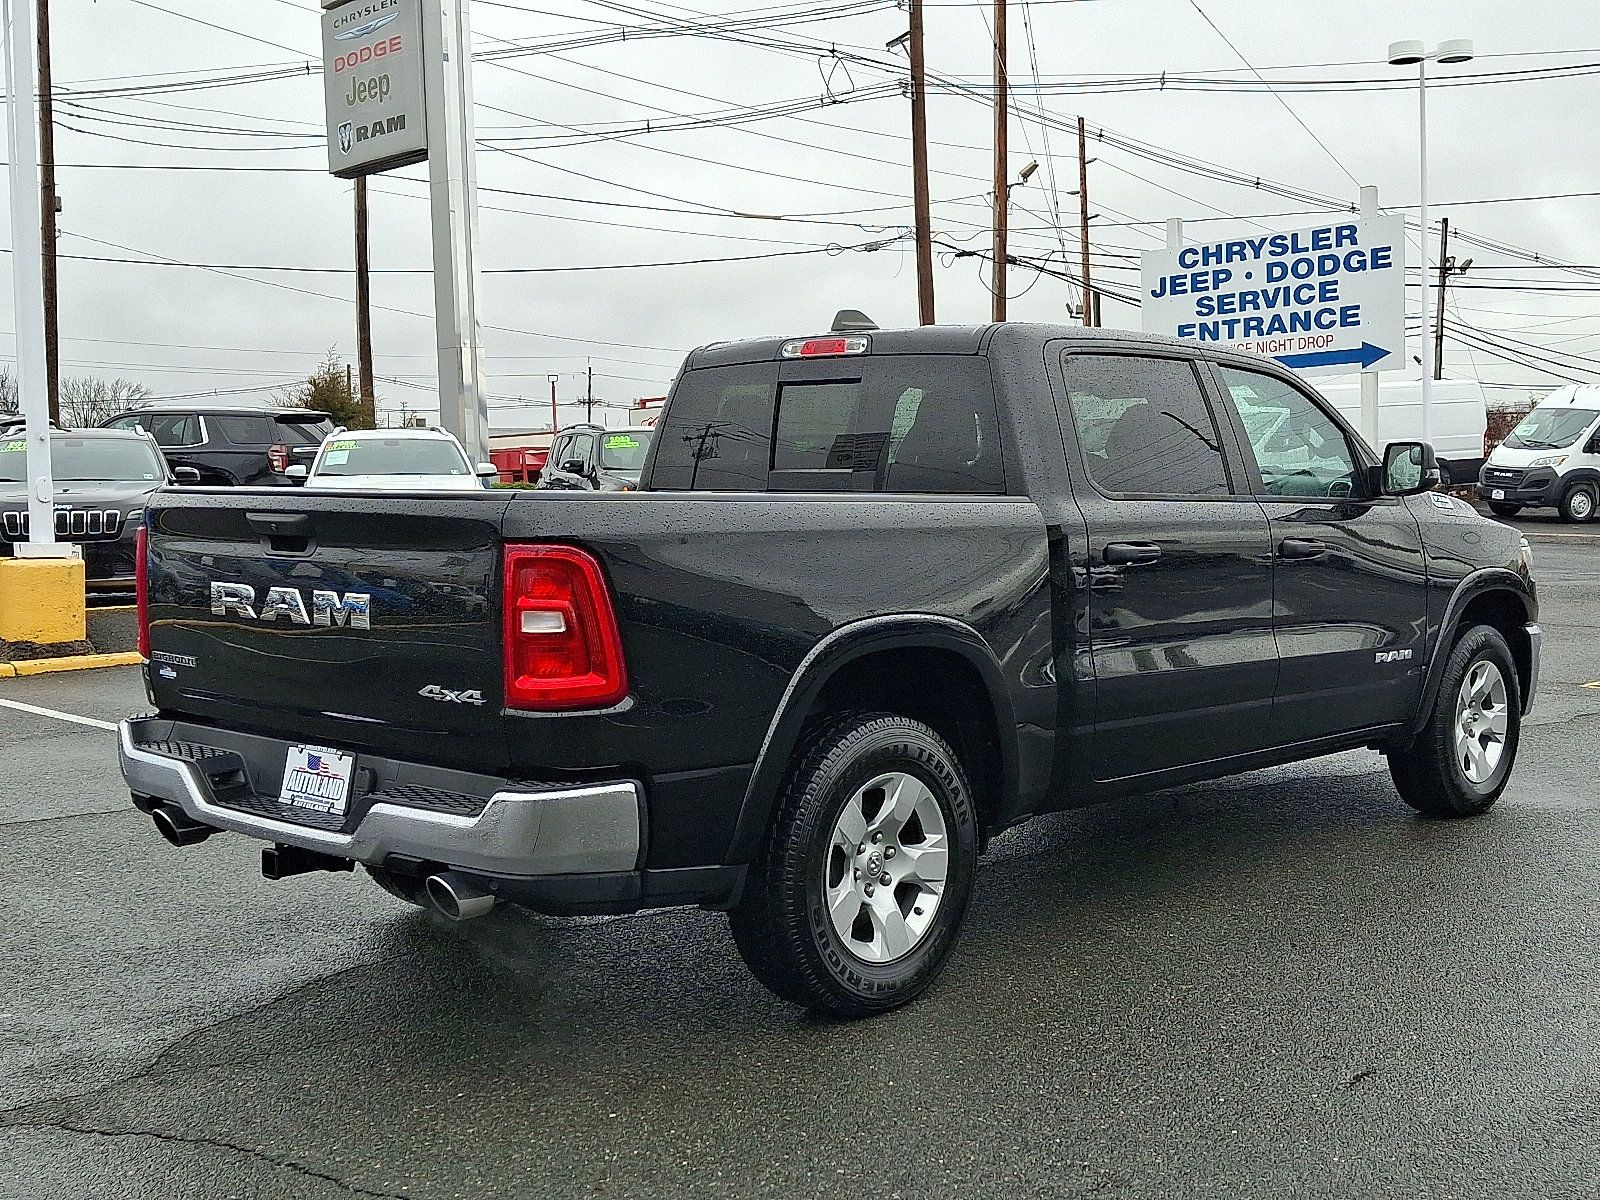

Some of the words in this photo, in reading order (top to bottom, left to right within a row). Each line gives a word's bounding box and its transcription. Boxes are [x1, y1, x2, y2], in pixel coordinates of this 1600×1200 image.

[334, 35, 402, 73] DODGE
[346, 74, 390, 106] Jeep
[356, 114, 406, 142] RAM
[1178, 224, 1358, 269] CHRYSLER
[1150, 268, 1232, 298] JEEP
[1266, 246, 1392, 283] DODGE
[1195, 280, 1339, 316] SERVICE
[1177, 304, 1361, 341] ENTRANCE
[1256, 338, 1294, 353] NIGHT
[1298, 334, 1334, 350] DROP
[210, 581, 371, 630] RAM
[1375, 649, 1412, 663] RAM
[287, 770, 344, 800] AUTOLAND
[917, 745, 970, 828] TERRAIN
